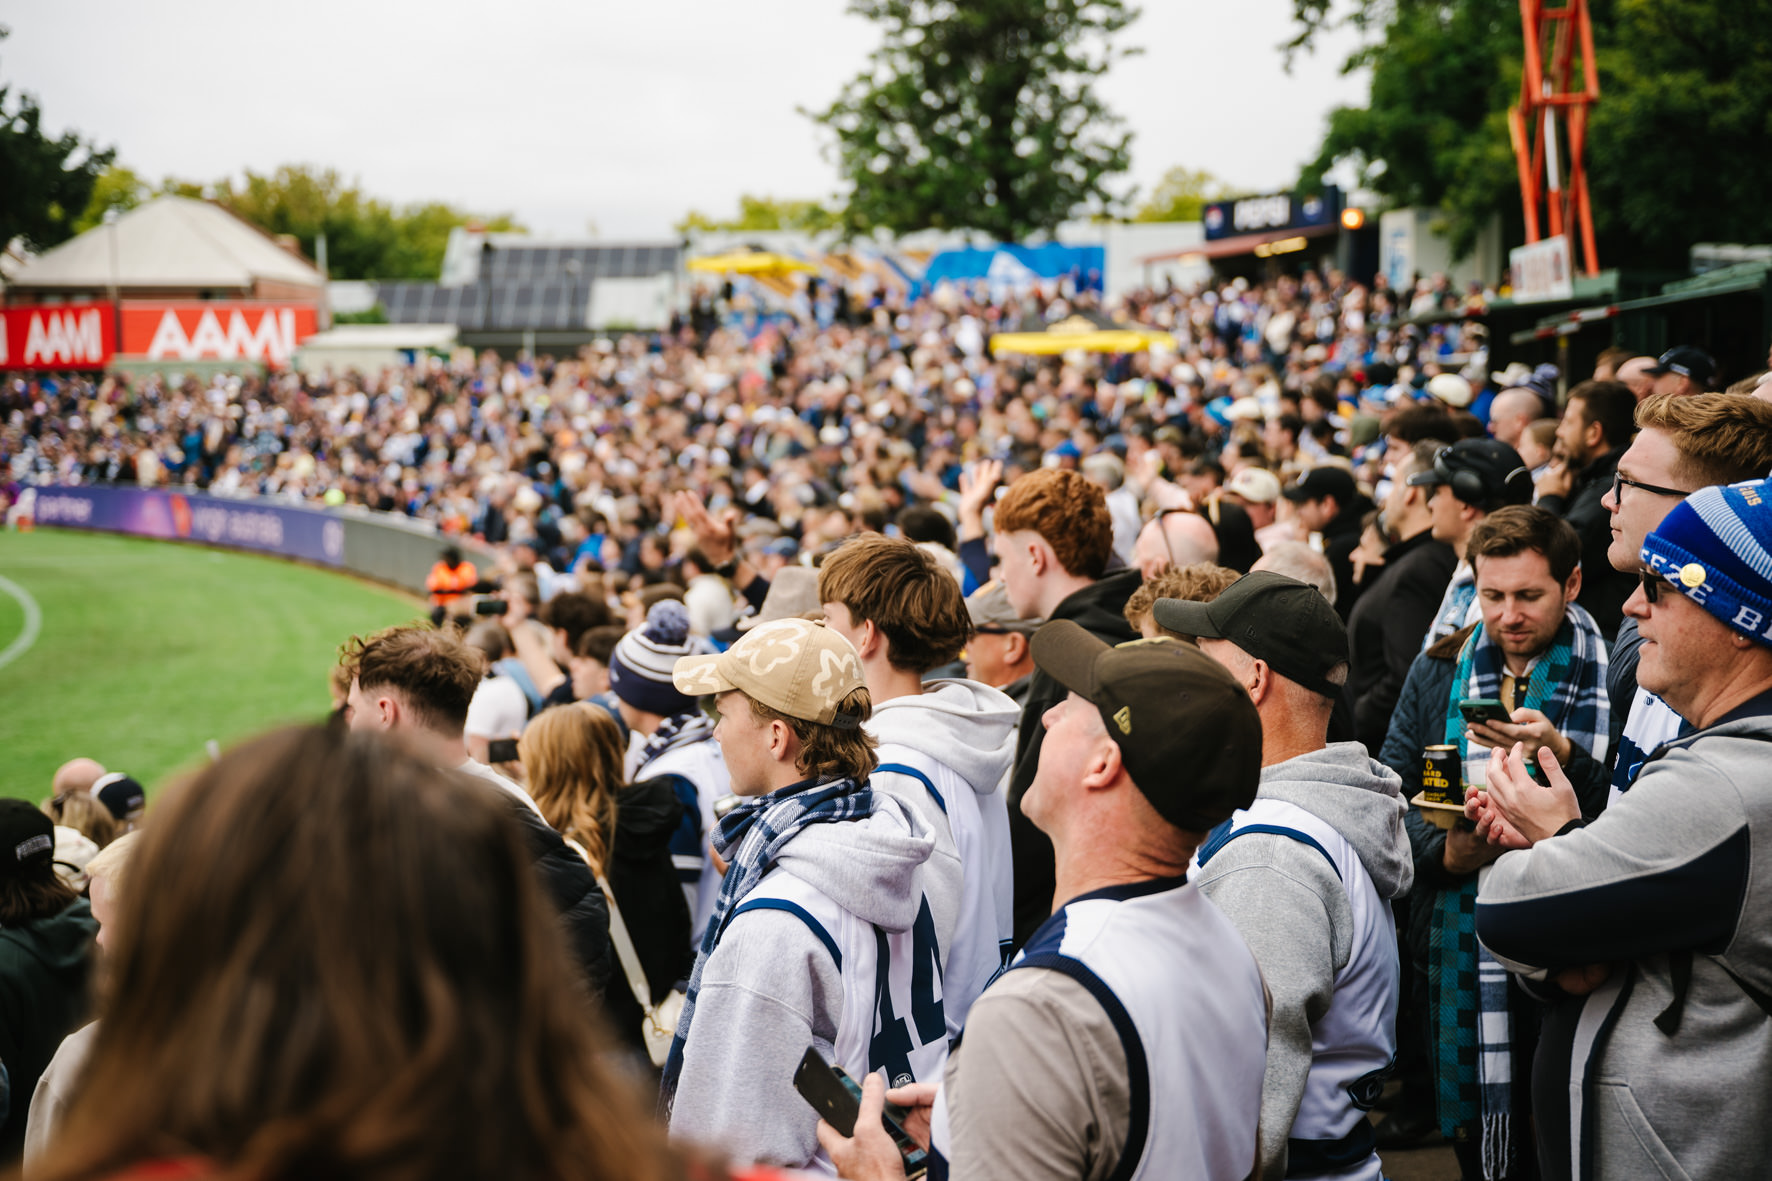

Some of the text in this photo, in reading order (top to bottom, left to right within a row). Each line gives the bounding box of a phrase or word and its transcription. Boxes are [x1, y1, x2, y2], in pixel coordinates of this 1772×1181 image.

[24, 309, 102, 363] AAMI
[148, 308, 296, 362] AAMI
[1423, 777, 1449, 788] ATED
